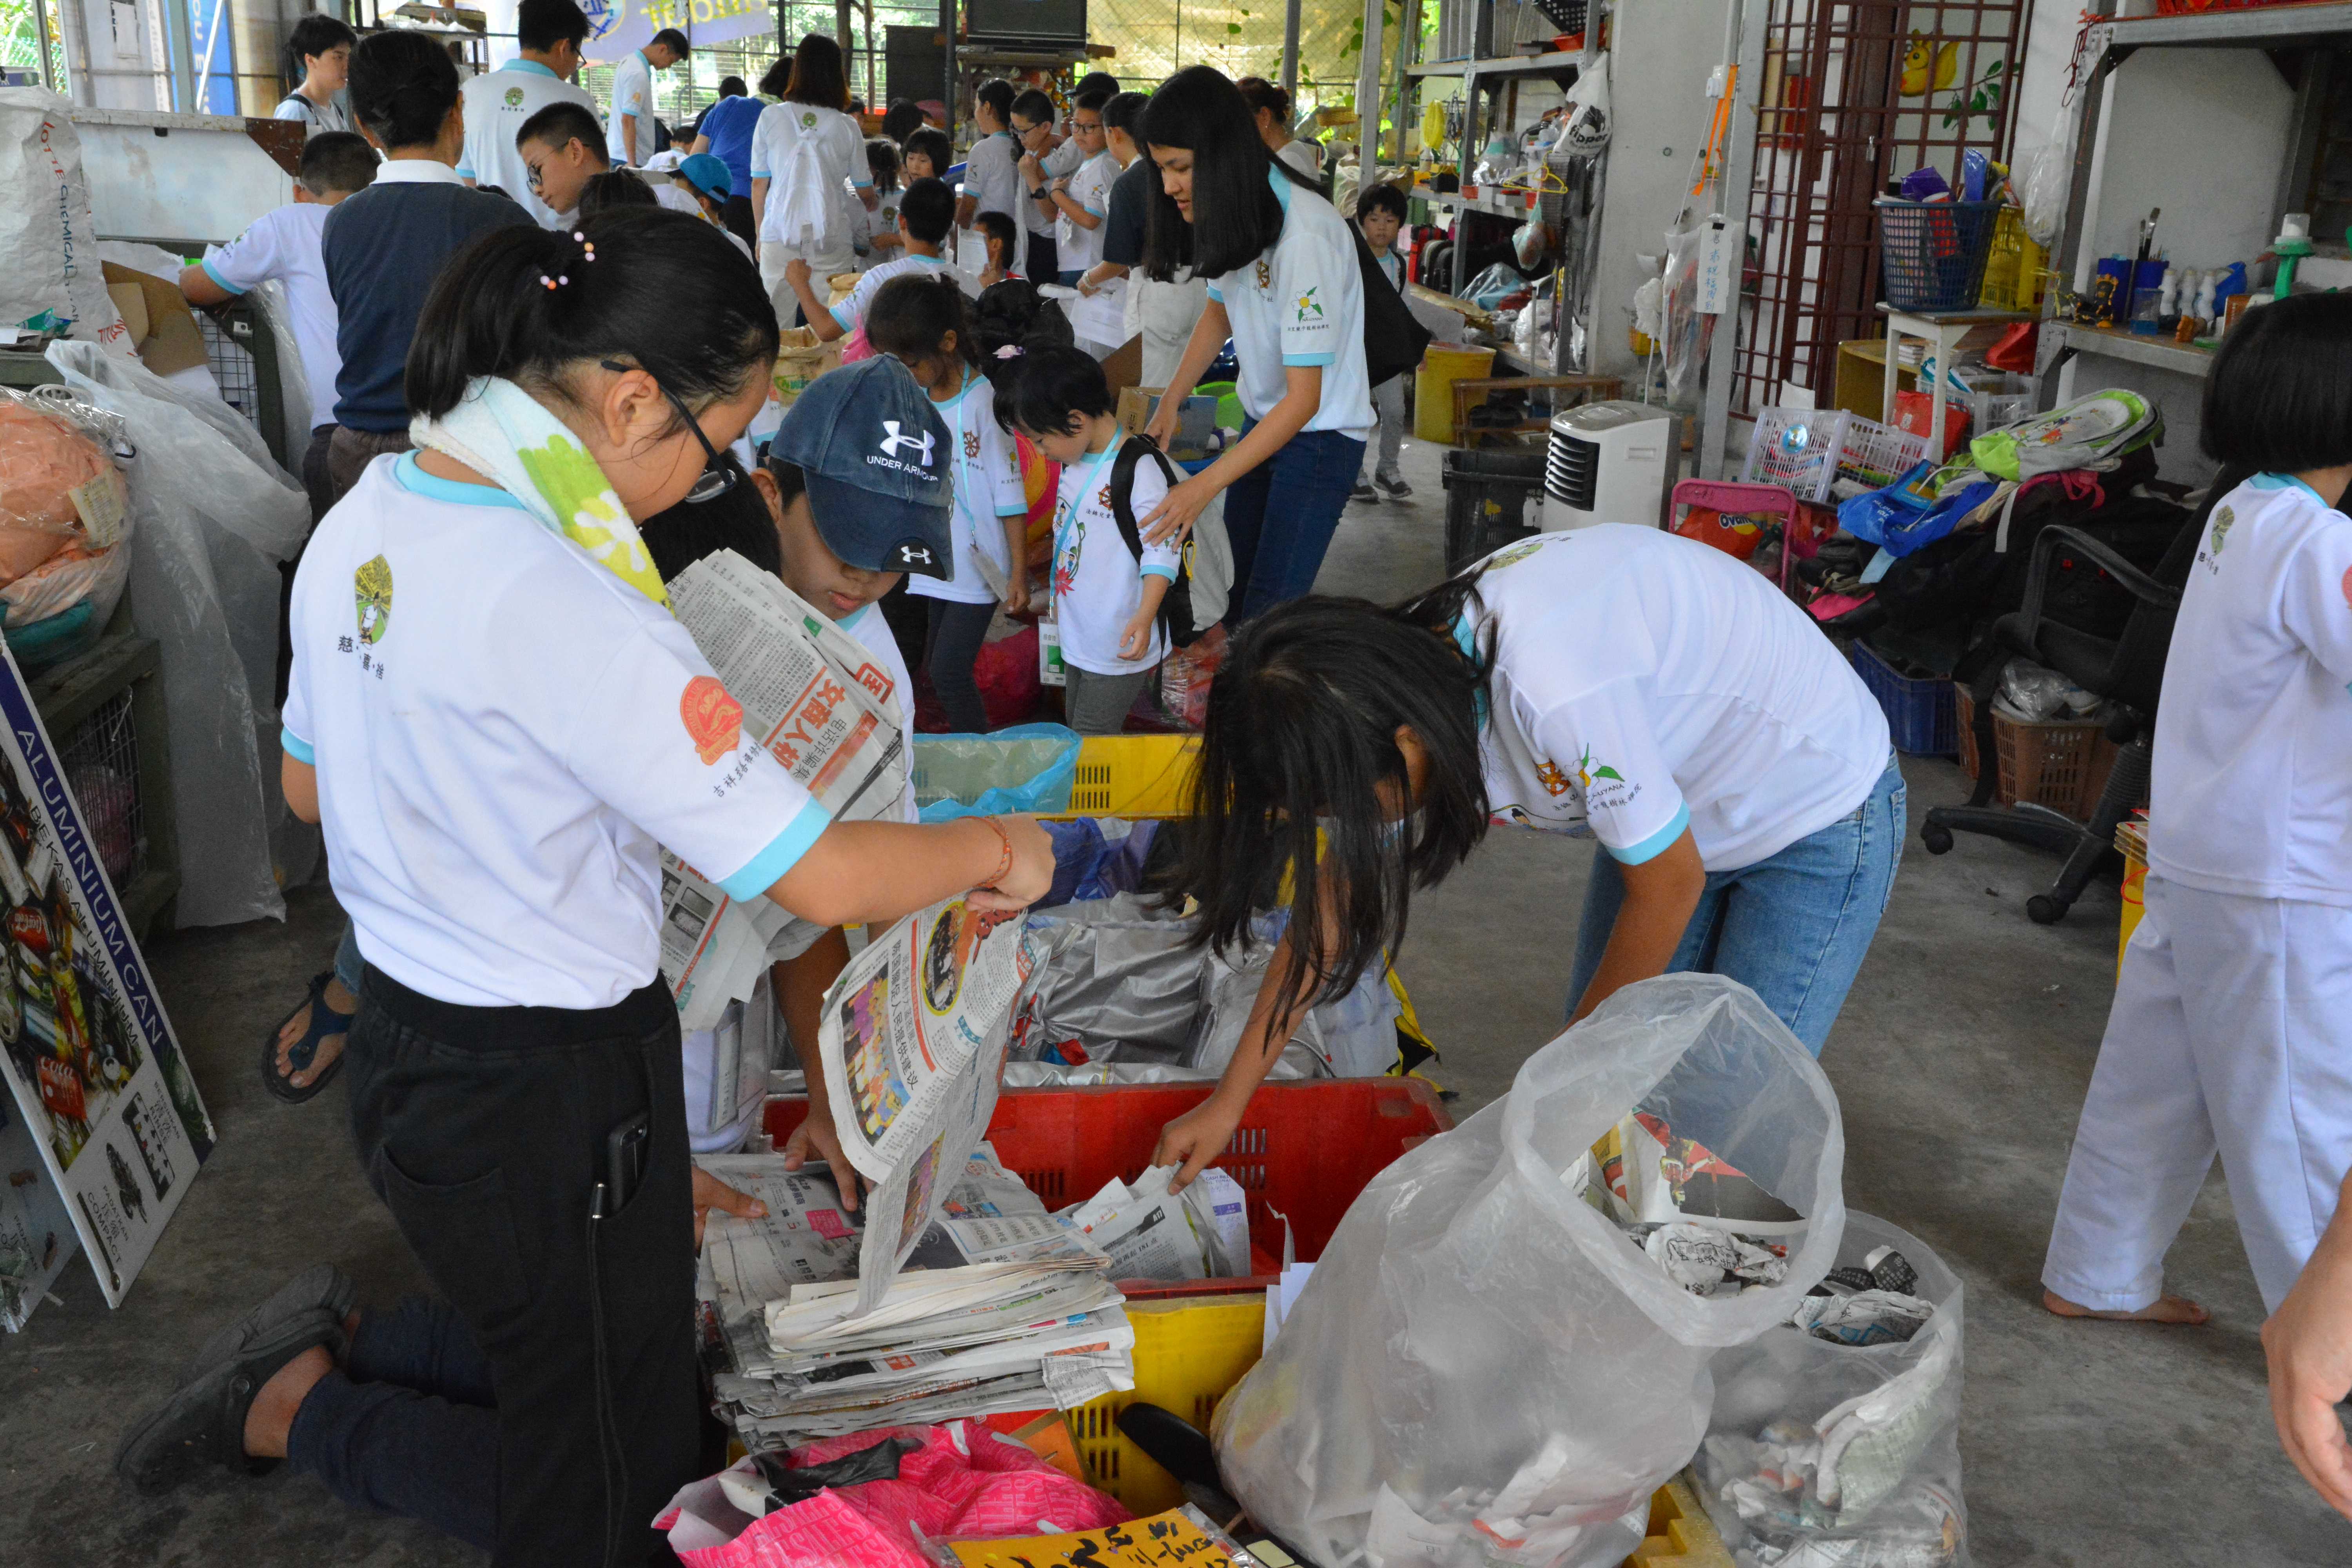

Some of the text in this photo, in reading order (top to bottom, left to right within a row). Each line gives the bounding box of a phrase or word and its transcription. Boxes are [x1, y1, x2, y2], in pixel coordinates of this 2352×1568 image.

[1569, 124, 1608, 145] fipper
[867, 455, 938, 481] UNDER ARMOUR
[18, 730, 164, 1046] ALUMINIUM CAN
[29, 805, 139, 1045] BEKAS ALUMINIUM
[87, 1192, 122, 1263] COMPACT
[103, 1184, 129, 1242] PADATKAN
